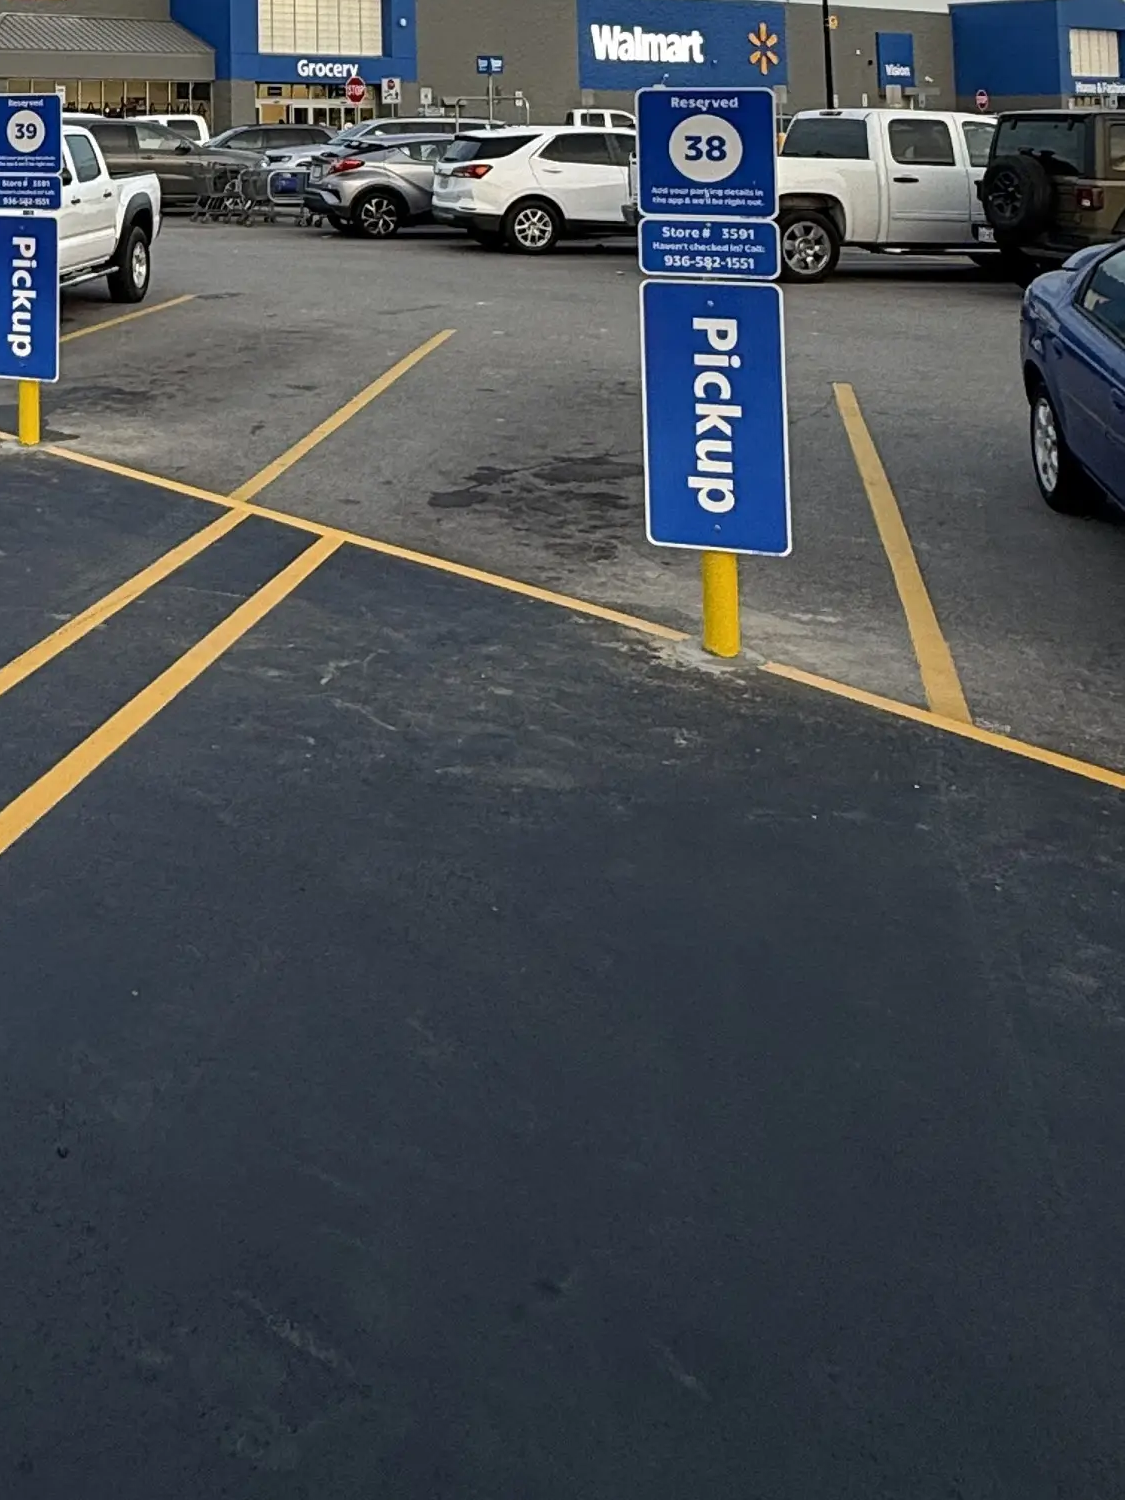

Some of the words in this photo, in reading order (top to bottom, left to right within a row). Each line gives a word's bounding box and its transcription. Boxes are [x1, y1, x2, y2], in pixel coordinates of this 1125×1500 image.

[590, 24, 704, 64] Walmart
[297, 59, 358, 78] Grocery
[671, 97, 739, 109] Reserved
[15, 123, 37, 140] 39
[684, 135, 727, 162] 38
[662, 227, 699, 238] Store
[702, 228, 711, 239] #
[722, 228, 755, 240] 3591
[664, 255, 755, 269] 936-582-1551
[7, 236, 37, 357] Pickup
[687, 317, 742, 513] Pickup
